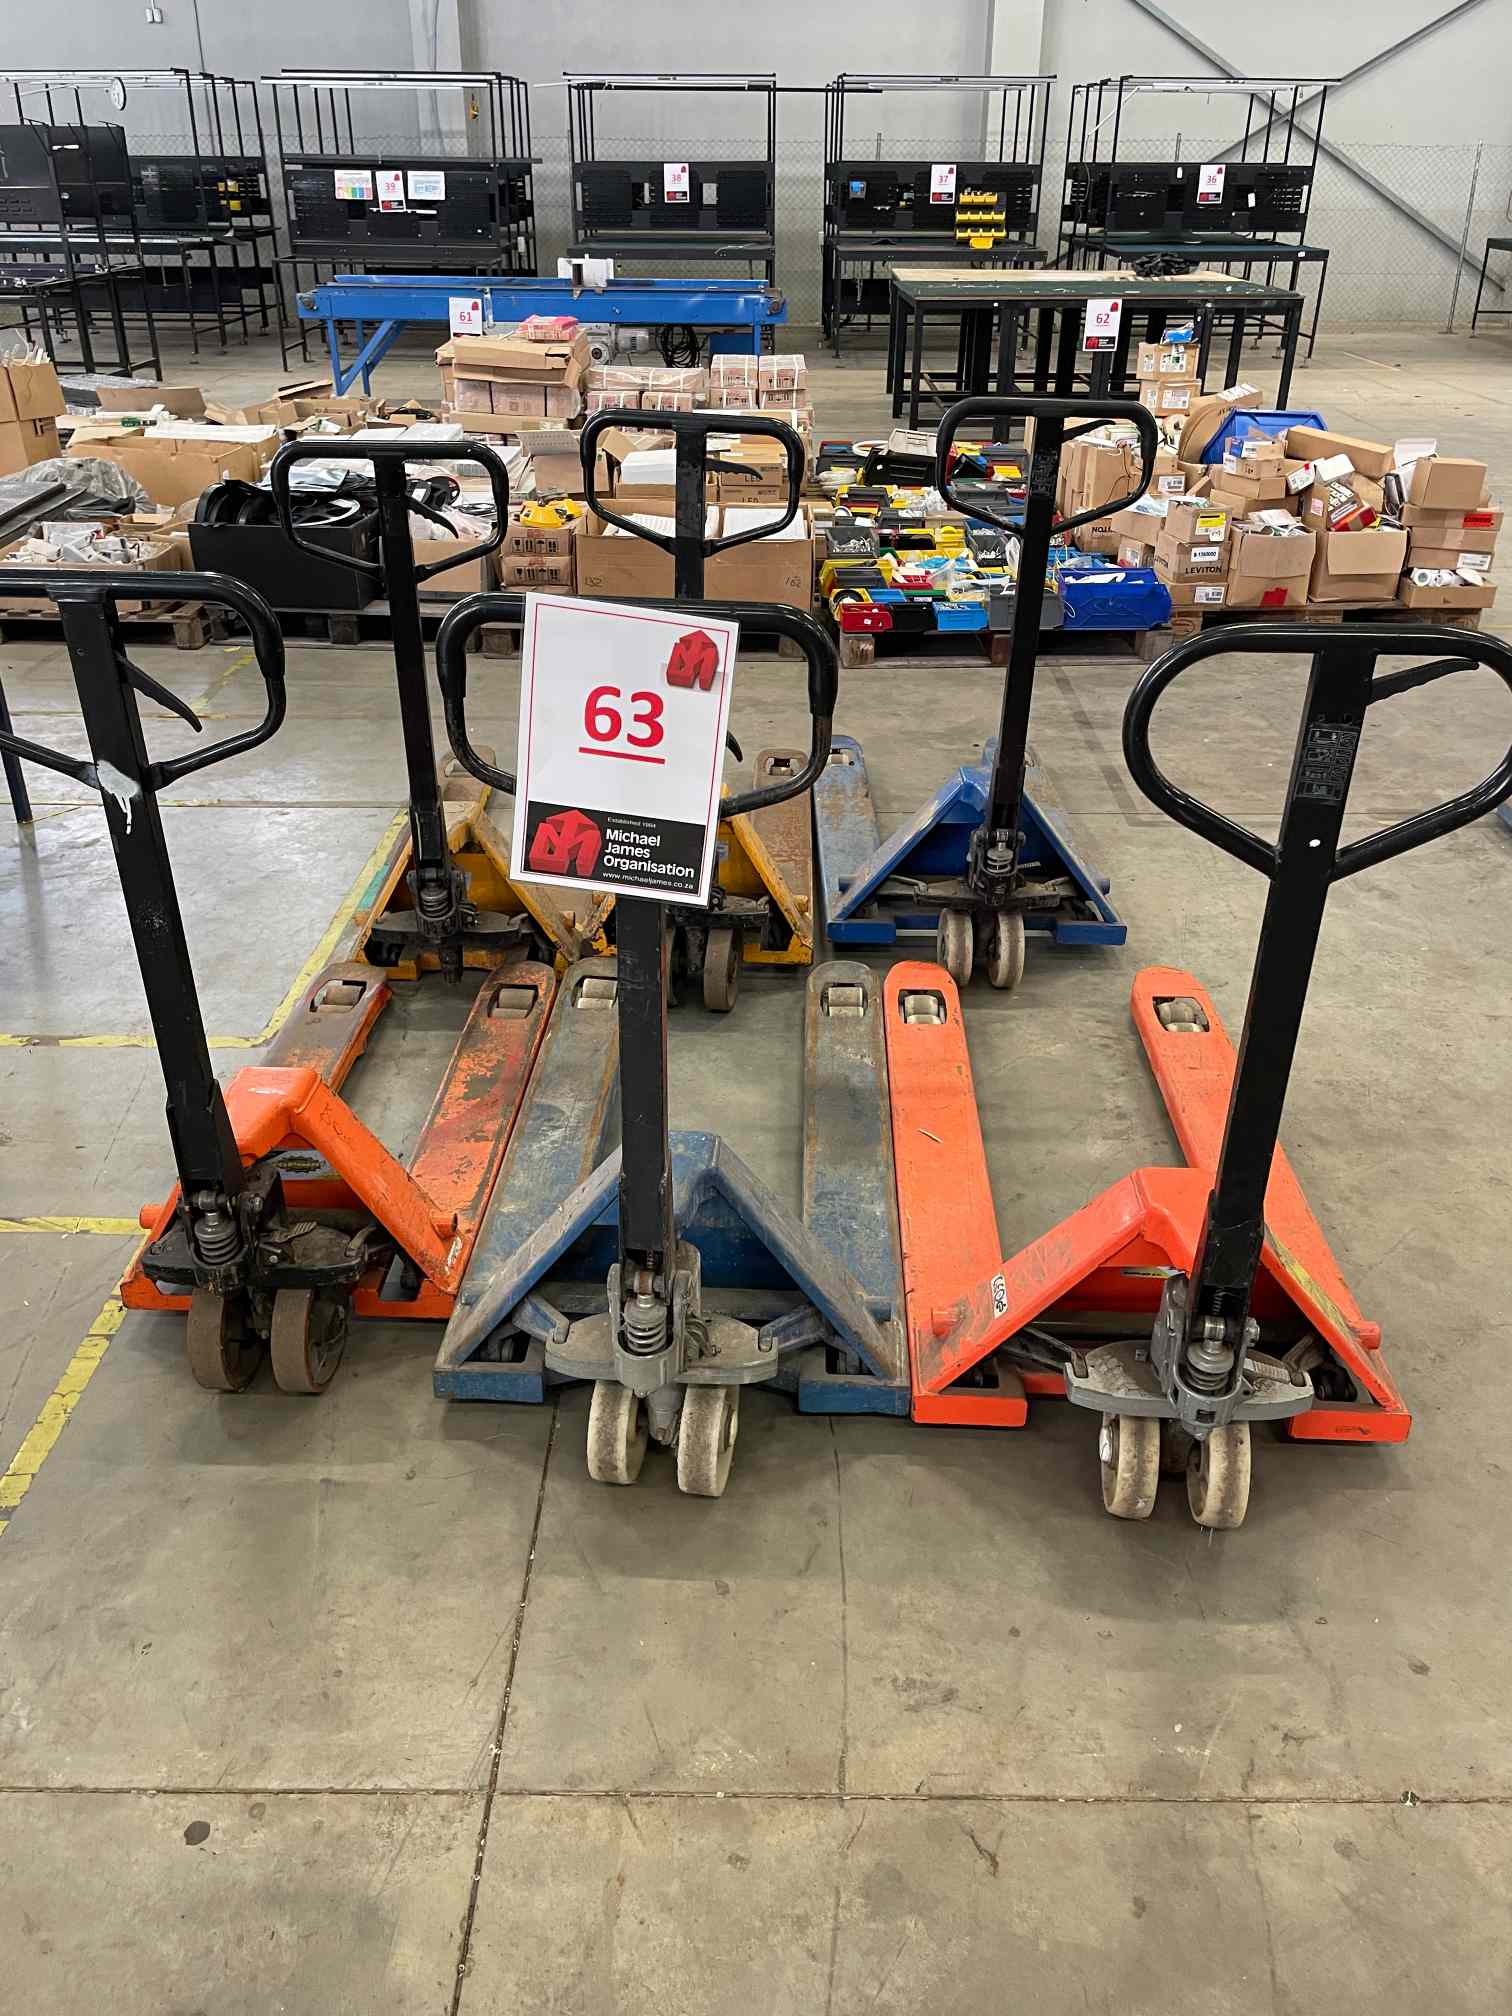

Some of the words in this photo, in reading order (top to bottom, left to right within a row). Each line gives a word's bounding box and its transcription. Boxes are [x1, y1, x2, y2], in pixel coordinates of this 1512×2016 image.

[938, 175, 949, 184] 37
[1207, 175, 1217, 184] 36
[385, 183, 396, 191] 39
[460, 312, 472, 321] 61
[1096, 313, 1110, 324] 62
[1185, 566, 1222, 575] LEVITON
[585, 686, 664, 748] 63
[607, 816, 641, 826] Established
[606, 828, 661, 847] Michael
[604, 842, 651, 859] James
[603, 855, 695, 879] Organisation
